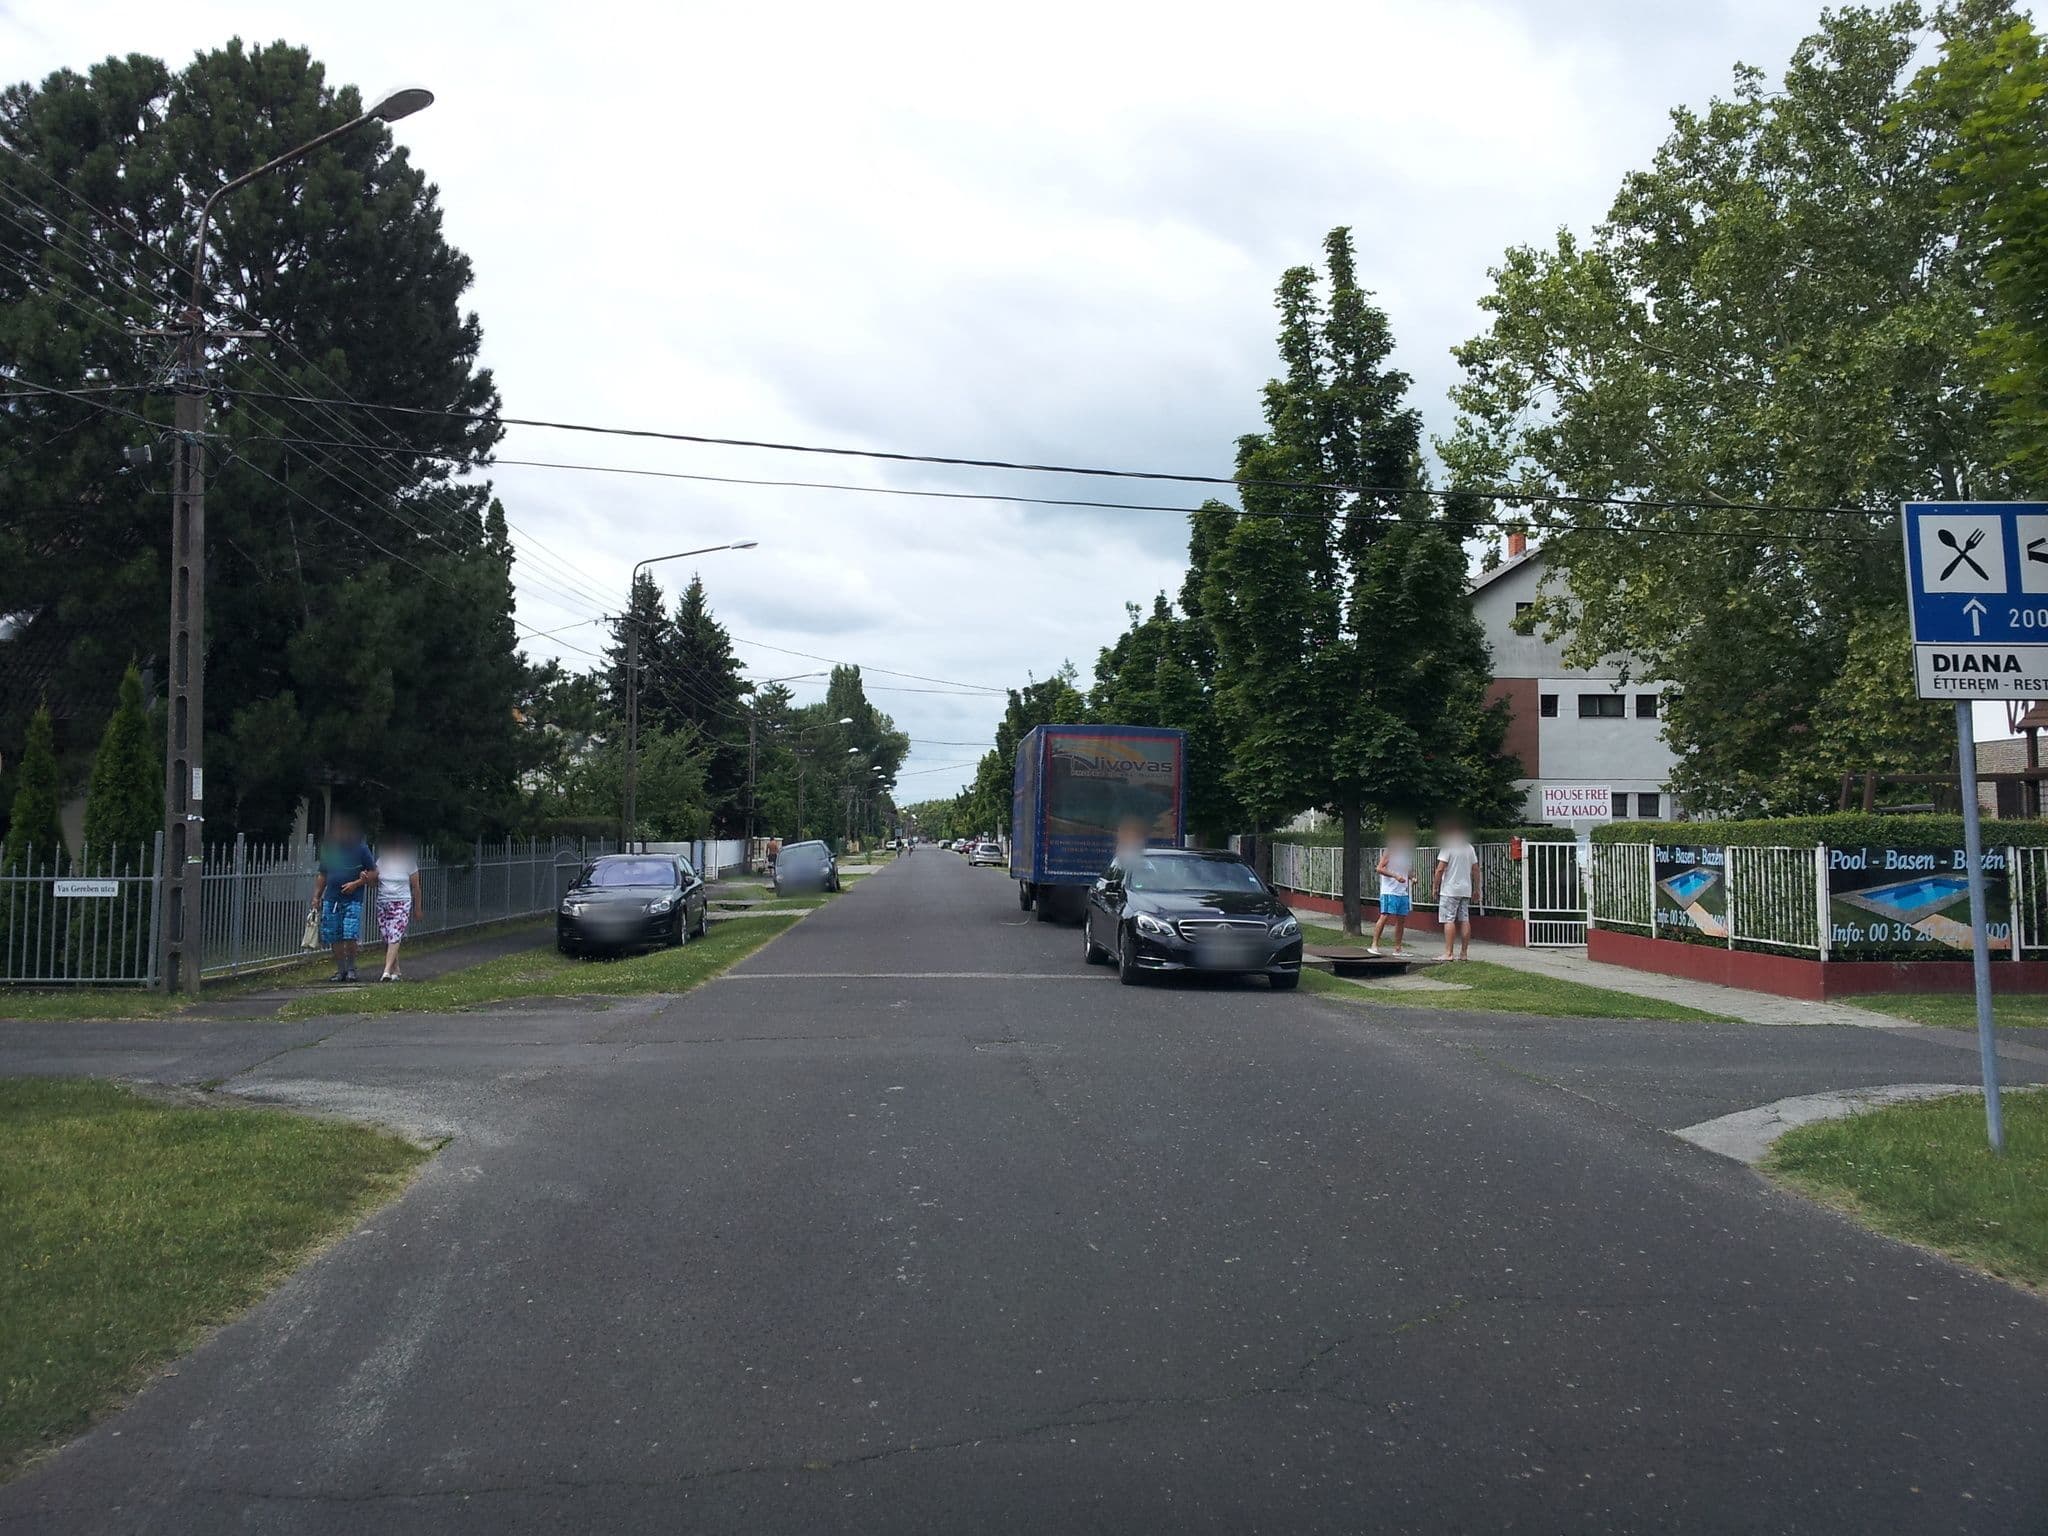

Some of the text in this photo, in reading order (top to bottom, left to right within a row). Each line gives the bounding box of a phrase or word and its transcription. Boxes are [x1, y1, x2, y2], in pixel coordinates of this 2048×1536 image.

[1932, 653, 2022, 673] DIANA
[1933, 675, 1999, 690] ÉTTEREM
[1545, 789, 1608, 800] HOUSE FREE
[1546, 803, 1607, 816] HÁZ KIADÓ
[1655, 845, 1669, 863] Pool
[1675, 847, 1695, 864] Basen
[1830, 847, 1867, 870] Pool
[1884, 849, 1935, 870] Basen
[1831, 922, 1865, 947] Info:
[1869, 923, 1889, 942] 00
[1892, 923, 1911, 942] 36
